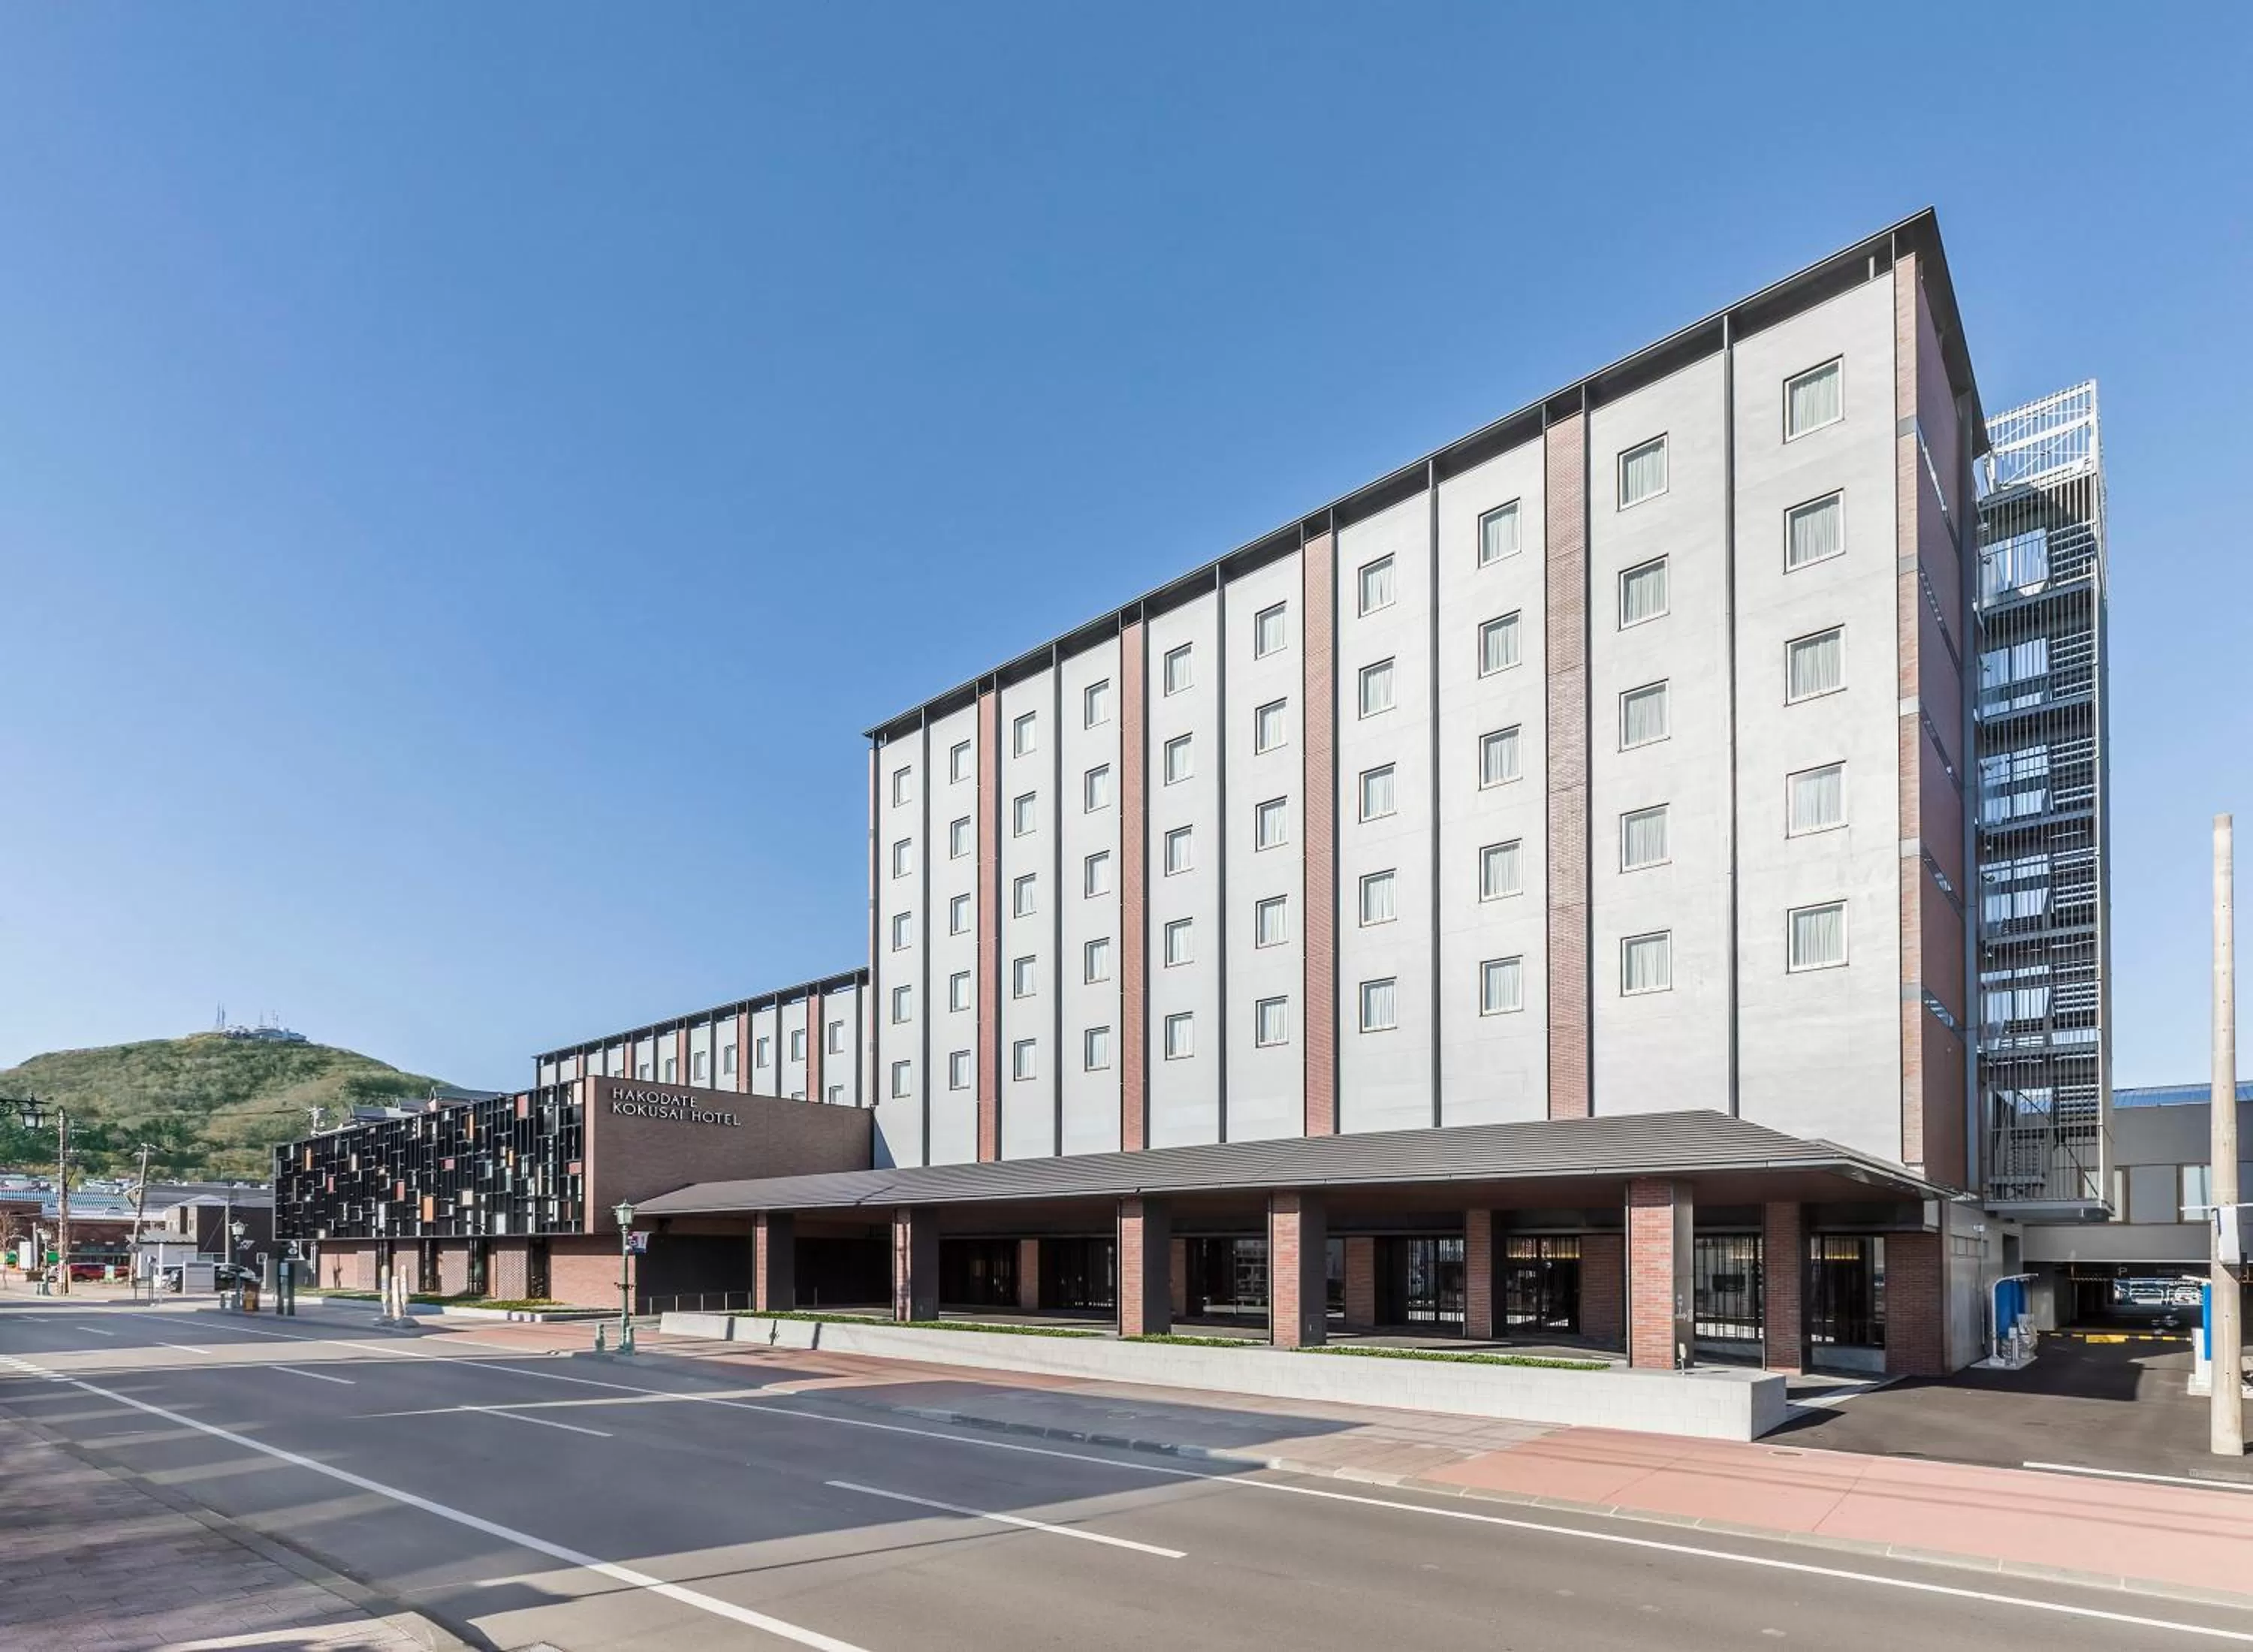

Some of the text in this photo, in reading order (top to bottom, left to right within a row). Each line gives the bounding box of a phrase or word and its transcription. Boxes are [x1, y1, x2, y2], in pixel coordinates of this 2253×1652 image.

[612, 1087, 698, 1108] HAKODATE
[612, 1102, 741, 1126] KOKUSAI HOTEL
